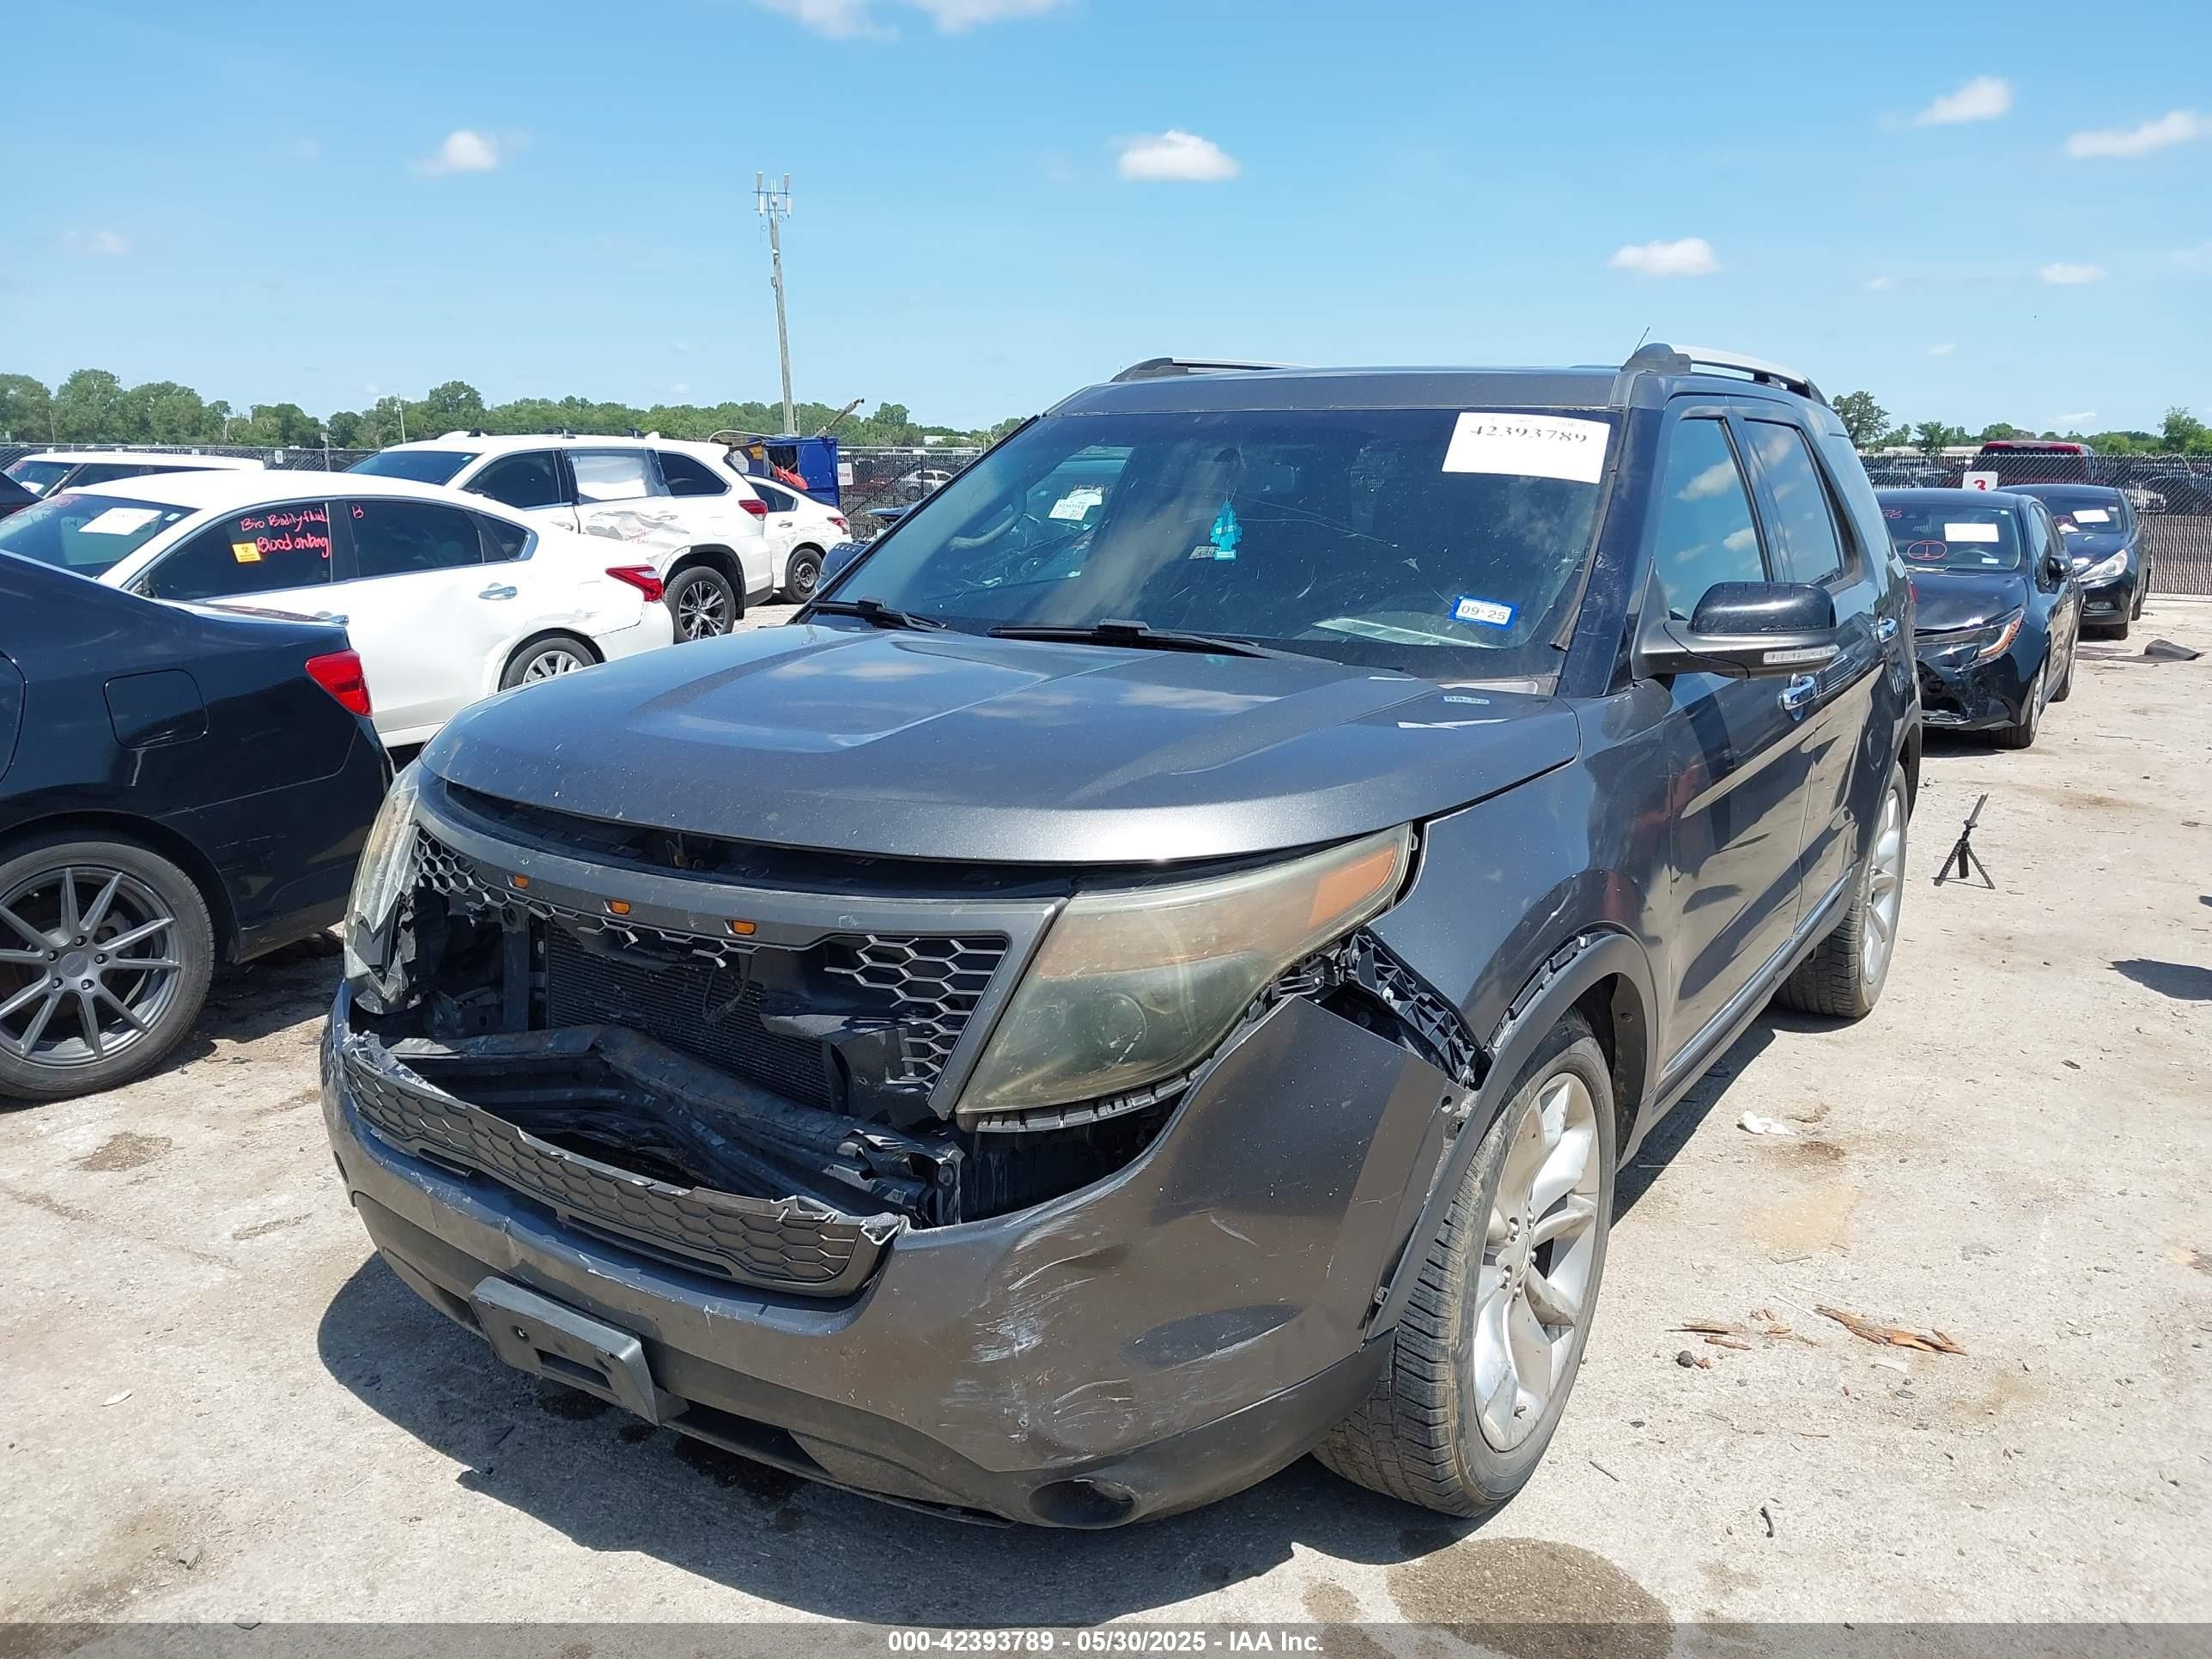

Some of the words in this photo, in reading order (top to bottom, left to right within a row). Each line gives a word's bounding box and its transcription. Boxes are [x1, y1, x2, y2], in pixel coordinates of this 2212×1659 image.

[1470, 425, 1588, 442] 42393789
[240, 517, 265, 532] Bio
[1461, 605, 1480, 616] 09
[1486, 610, 1507, 621] 25
